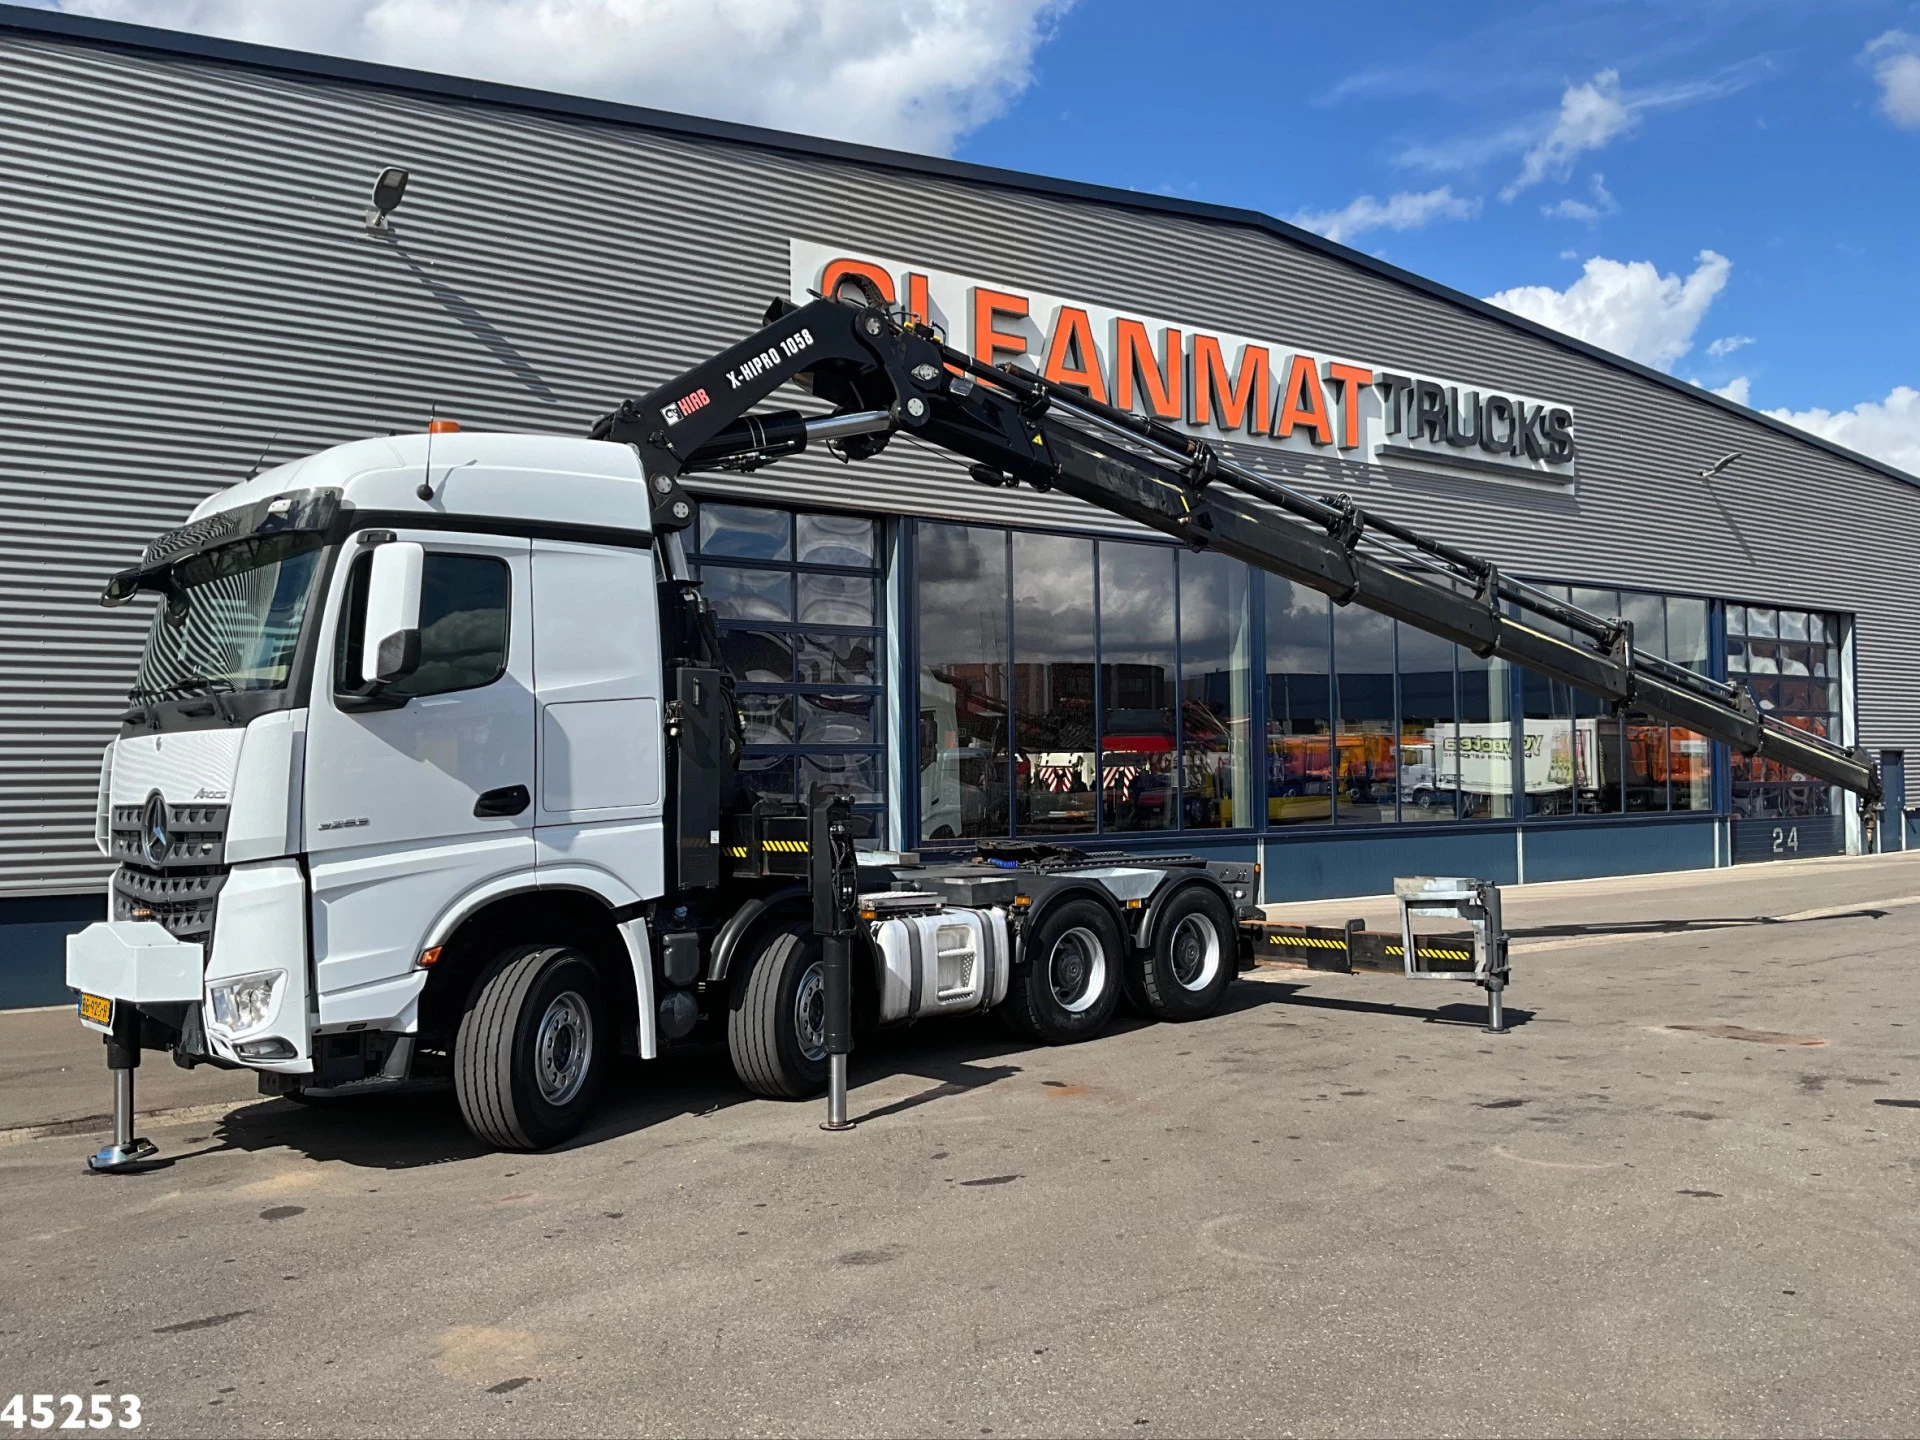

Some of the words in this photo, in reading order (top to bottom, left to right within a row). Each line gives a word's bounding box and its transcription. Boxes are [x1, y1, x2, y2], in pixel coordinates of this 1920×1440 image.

[726, 346, 781, 389] X-HIPRO
[779, 328, 814, 358] 1058
[676, 388, 711, 416] HIAB
[1374, 372, 1574, 464] TRUCKS
[1772, 826, 1799, 853] 24
